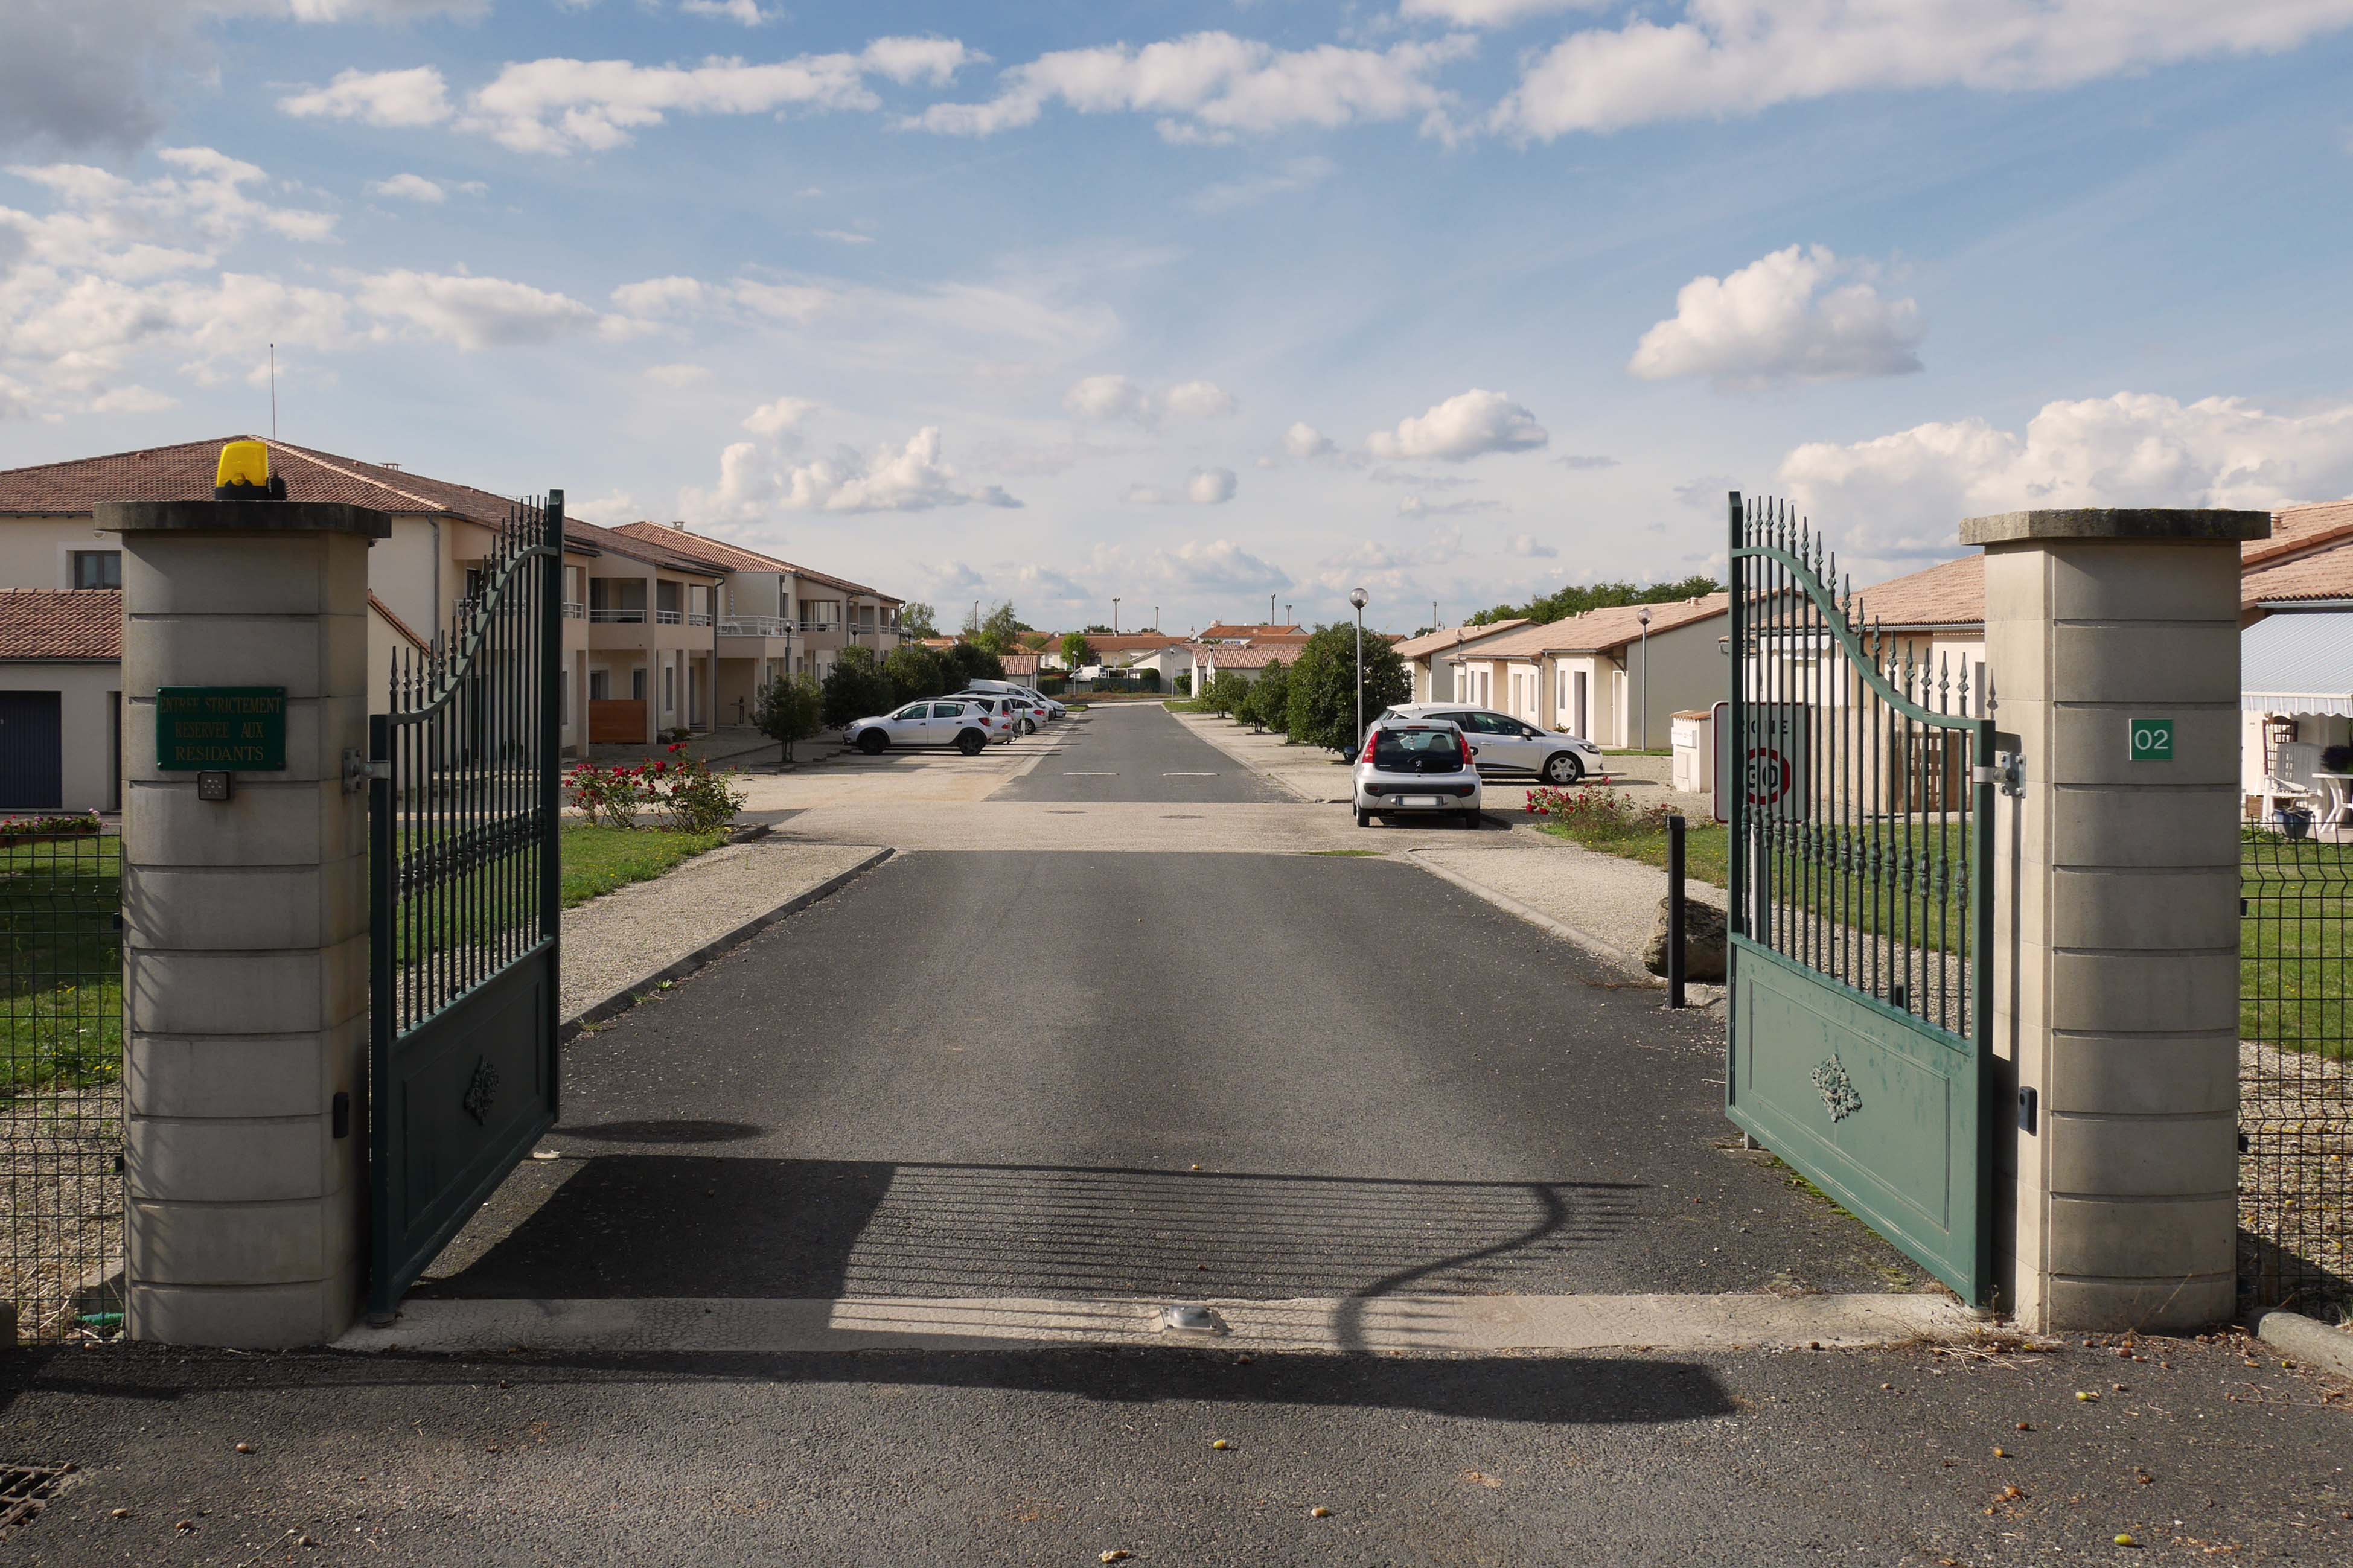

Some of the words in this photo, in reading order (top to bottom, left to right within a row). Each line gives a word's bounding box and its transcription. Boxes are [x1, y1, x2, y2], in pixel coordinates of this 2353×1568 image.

[205, 696, 282, 713] STRICTEMENT
[241, 721, 264, 738] AUX
[2135, 729, 2168, 750] 02
[174, 743, 264, 761] RÉSIDANTS
